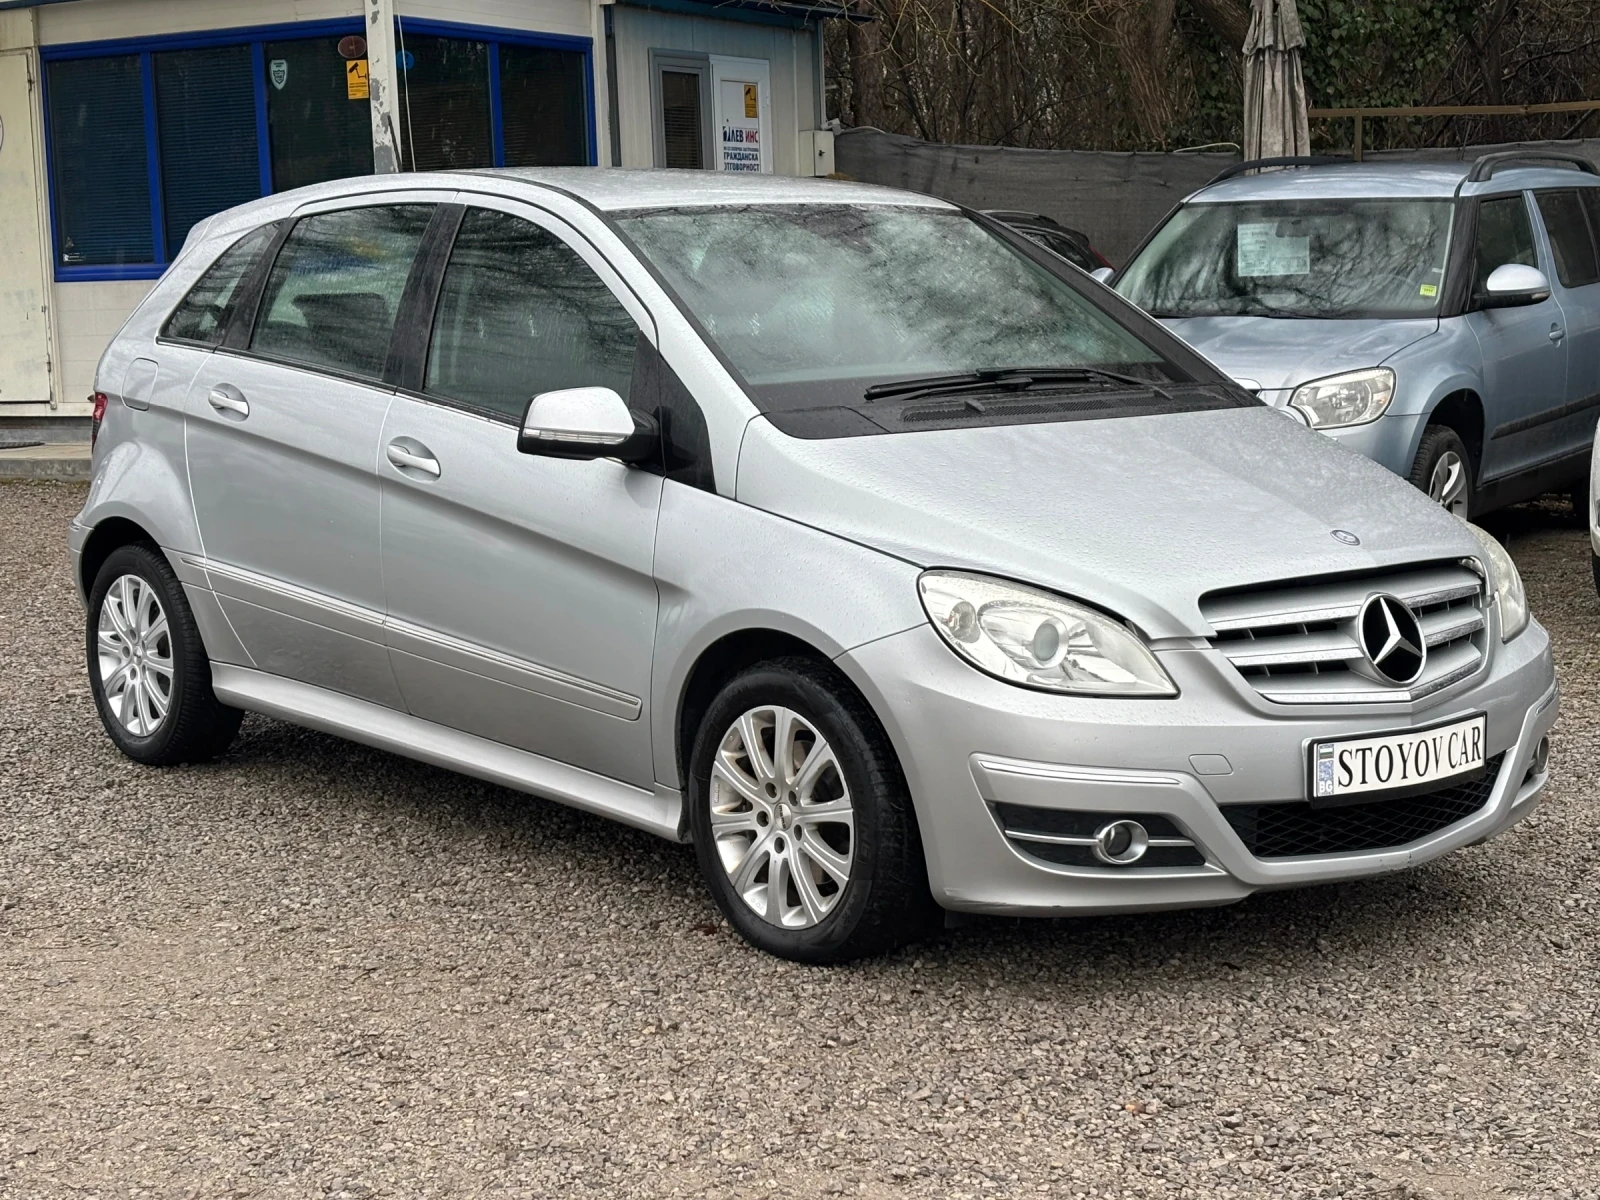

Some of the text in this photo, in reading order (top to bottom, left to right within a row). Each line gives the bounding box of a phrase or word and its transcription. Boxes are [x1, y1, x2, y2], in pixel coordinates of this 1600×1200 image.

[731, 129, 759, 143] ЛЕВ ИНС
[723, 152, 758, 161] ГРАЖДАНСКА
[1338, 726, 1482, 788] STOYOV CAR
[1319, 781, 1333, 793] BG
